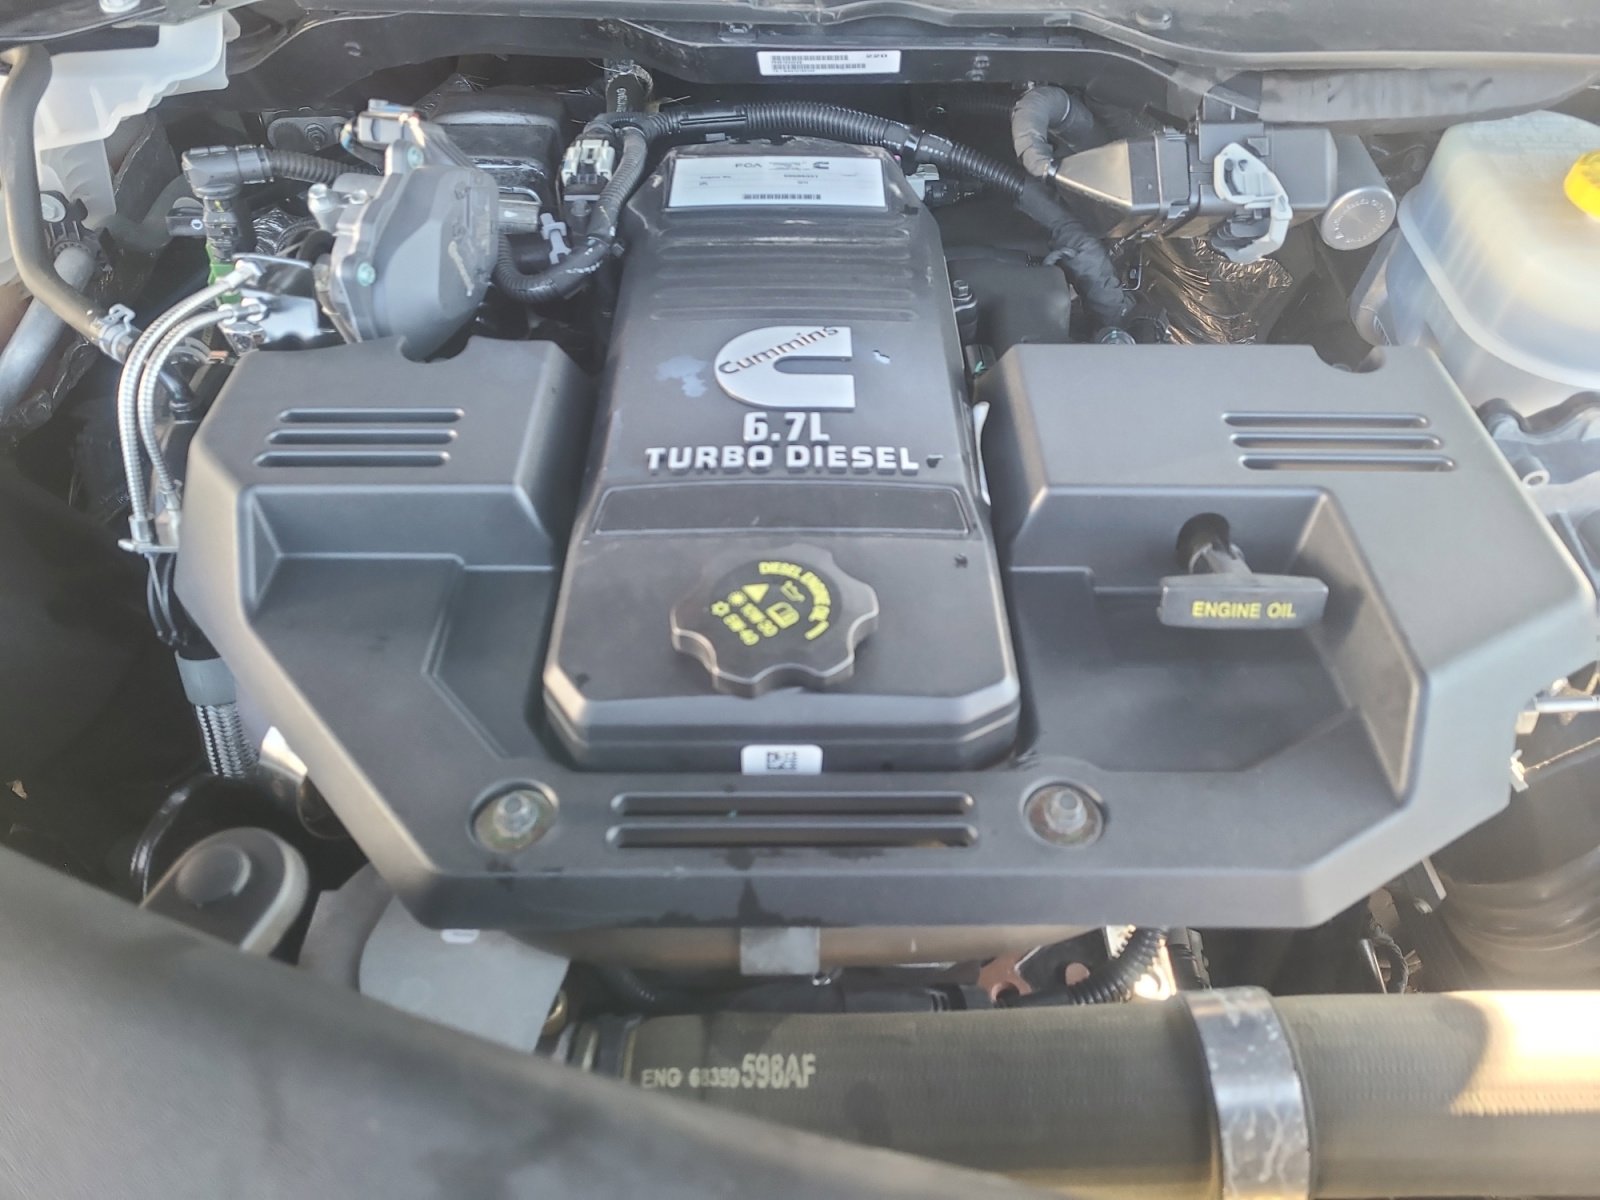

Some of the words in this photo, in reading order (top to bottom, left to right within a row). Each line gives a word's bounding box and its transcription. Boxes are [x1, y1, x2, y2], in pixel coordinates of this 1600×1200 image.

[718, 326, 839, 375] Cummins
[743, 412, 830, 442] 6.7L
[646, 446, 773, 471] TURBO
[786, 446, 919, 472] DIESEL
[1191, 600, 1262, 618] ENGINE
[1266, 602, 1297, 618] OIL
[641, 1067, 682, 1088] ENG
